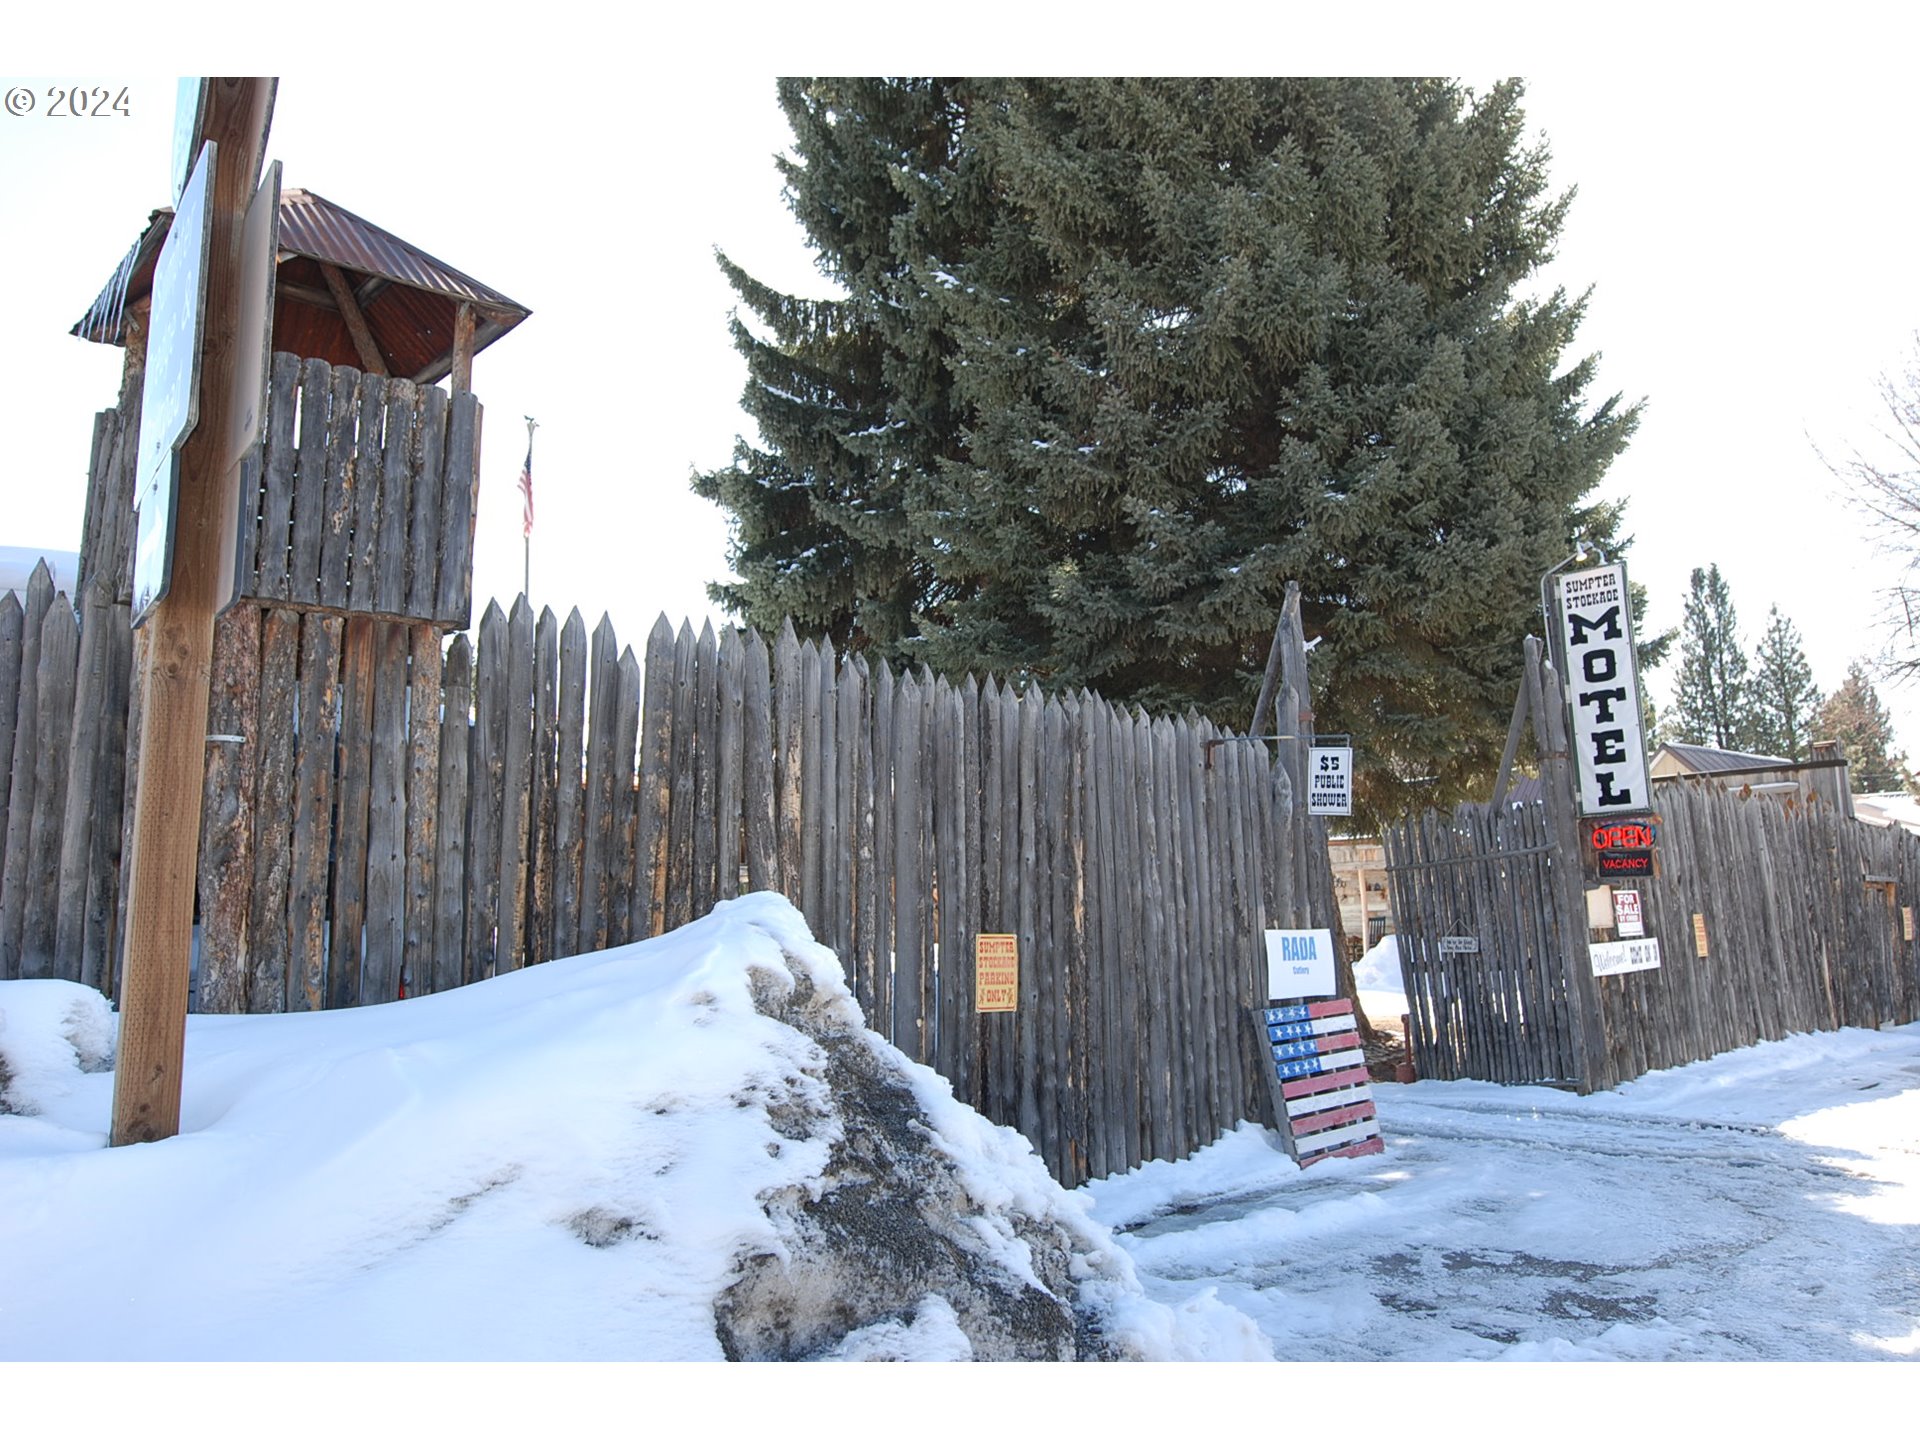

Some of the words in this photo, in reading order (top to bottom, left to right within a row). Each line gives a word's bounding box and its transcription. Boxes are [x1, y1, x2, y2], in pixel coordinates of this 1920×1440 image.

[1566, 573, 1616, 593] SUMPTER
[1566, 588, 1619, 609] STOCKADE
[1568, 605, 1632, 807] MOTEL
[1320, 755, 1340, 772] $5
[1314, 775, 1345, 789] PUBLIC
[1311, 793, 1347, 807] SHOWER
[1592, 826, 1652, 849] OPEN
[1602, 857, 1649, 869] VACANCY
[1617, 894, 1635, 904] FOR
[1616, 904, 1640, 915] SALE
[1281, 936, 1317, 961] RADA
[979, 971, 1014, 985] PARKING
[986, 989, 1007, 1002] ONLY
